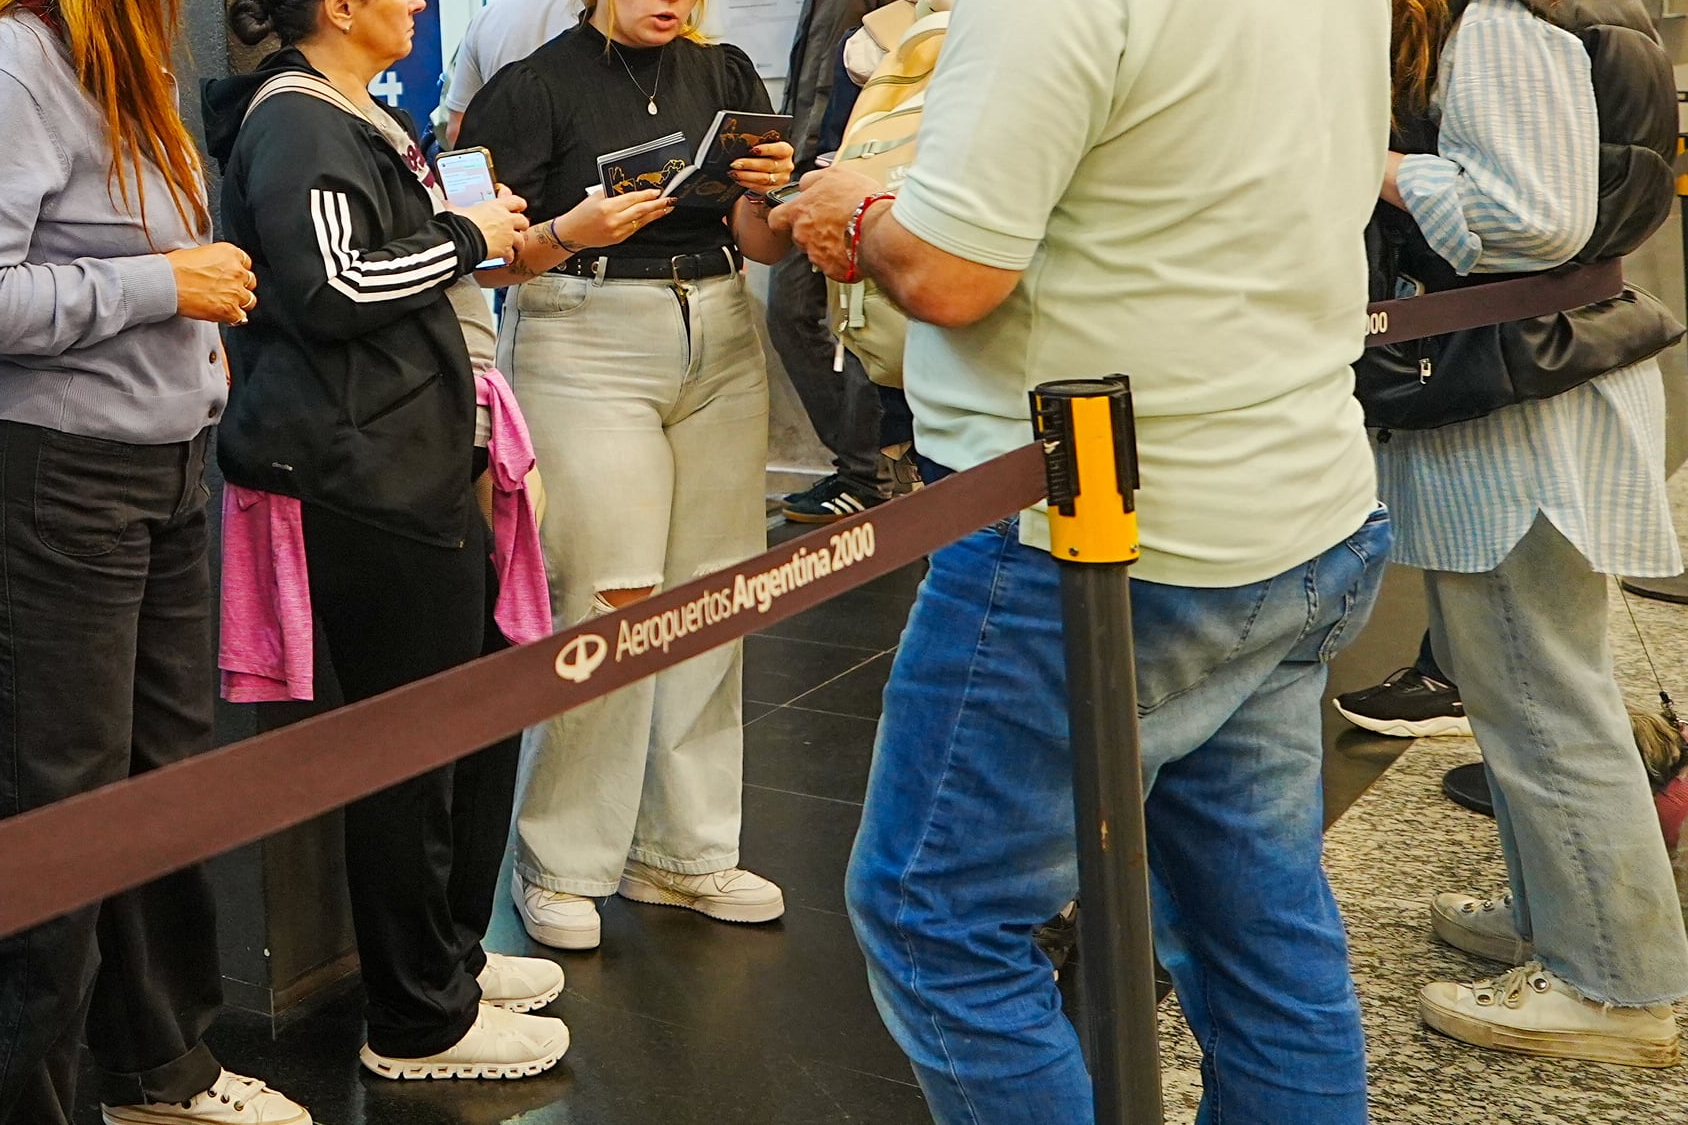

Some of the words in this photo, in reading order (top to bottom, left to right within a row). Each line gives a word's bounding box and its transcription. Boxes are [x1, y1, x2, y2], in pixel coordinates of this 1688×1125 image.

[615, 588, 732, 663] Aeropuertos
[732, 546, 831, 615] Argentina
[829, 522, 876, 572] 2000
